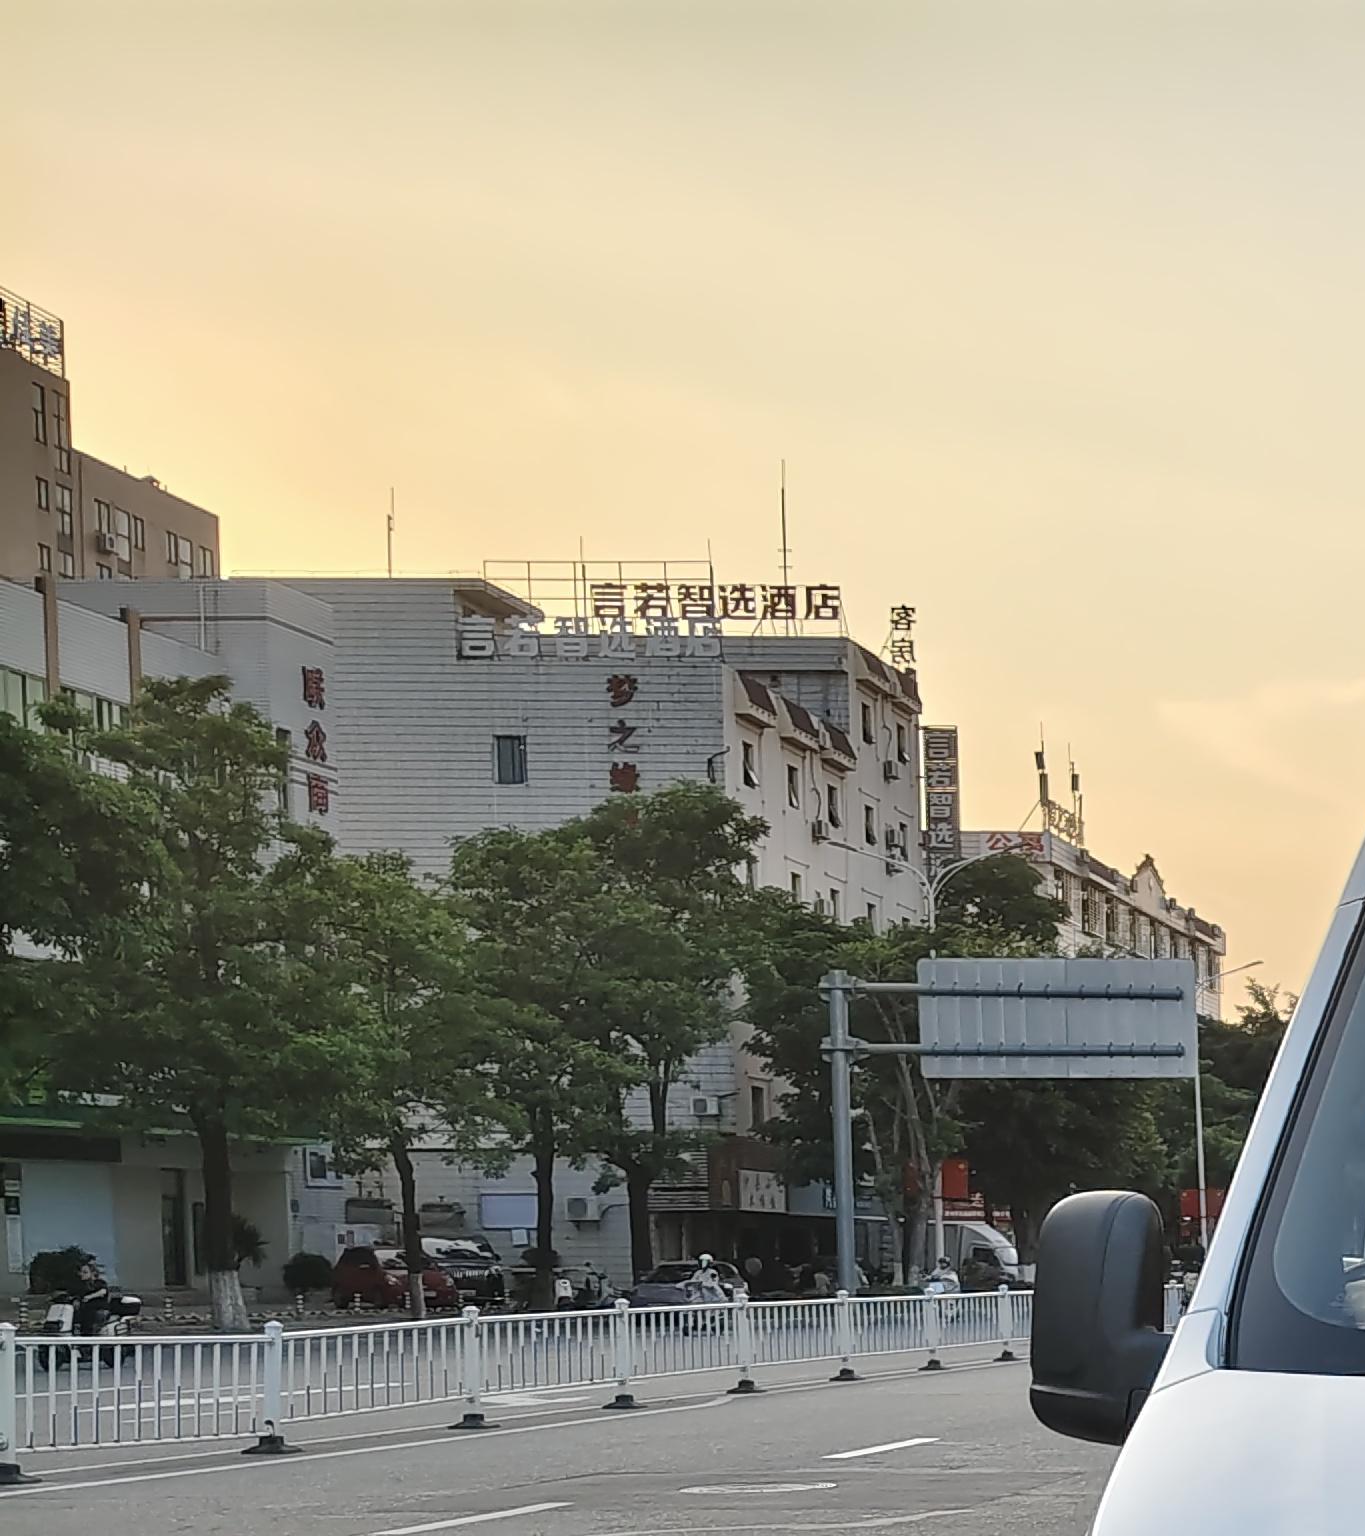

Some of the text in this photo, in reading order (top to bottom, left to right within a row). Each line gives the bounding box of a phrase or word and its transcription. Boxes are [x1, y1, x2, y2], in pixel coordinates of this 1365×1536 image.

[590, 583, 841, 621] 言若智选酒店
[456, 615, 722, 660] 言若智选酒店
